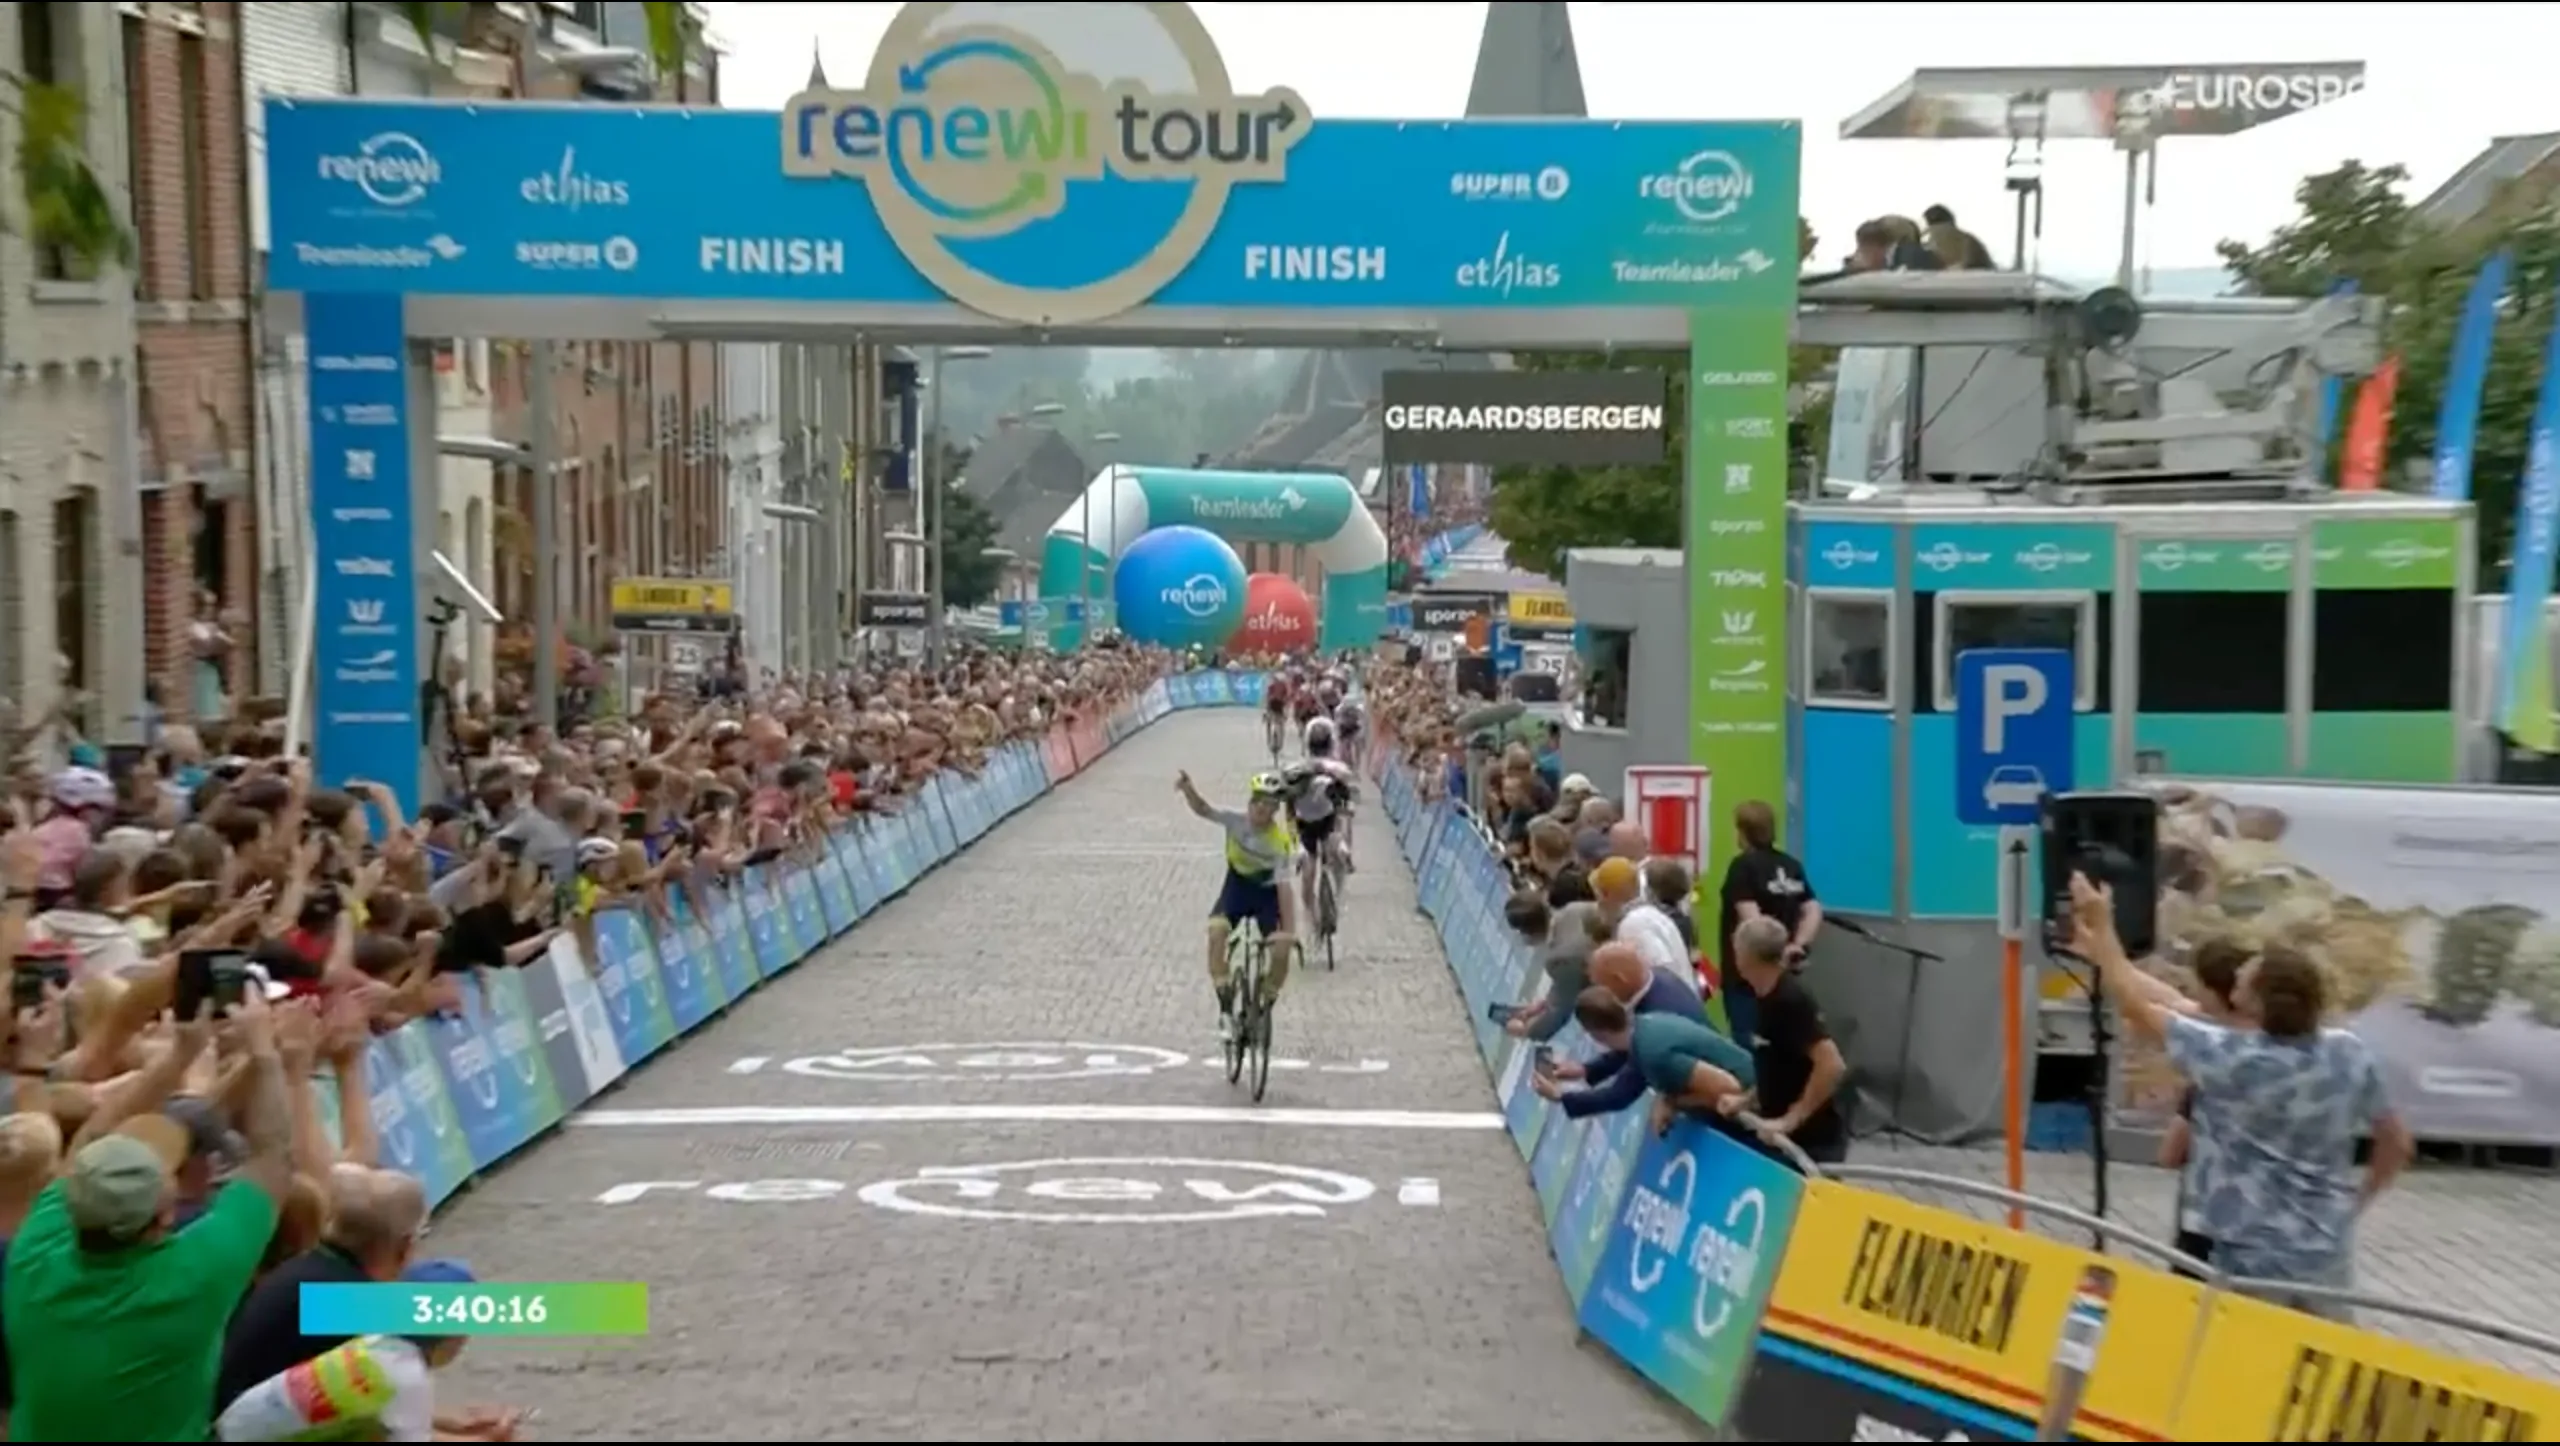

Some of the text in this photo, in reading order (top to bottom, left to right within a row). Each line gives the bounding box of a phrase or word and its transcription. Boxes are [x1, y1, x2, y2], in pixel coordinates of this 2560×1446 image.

[796, 95, 1296, 164] renewi tour
[519, 144, 630, 212] ethias
[1450, 171, 1530, 195] SUPER
[700, 236, 845, 275] FINISH
[1244, 244, 1387, 282] FINISH
[1456, 230, 1561, 300] ethias
[1612, 258, 1743, 284] Teamleader
[1384, 404, 1664, 431] GERAARDSBERGEN
[1248, 600, 1301, 633] ethias
[1983, 664, 2047, 755] P
[1843, 1217, 2031, 1354] FLANDRIEN
